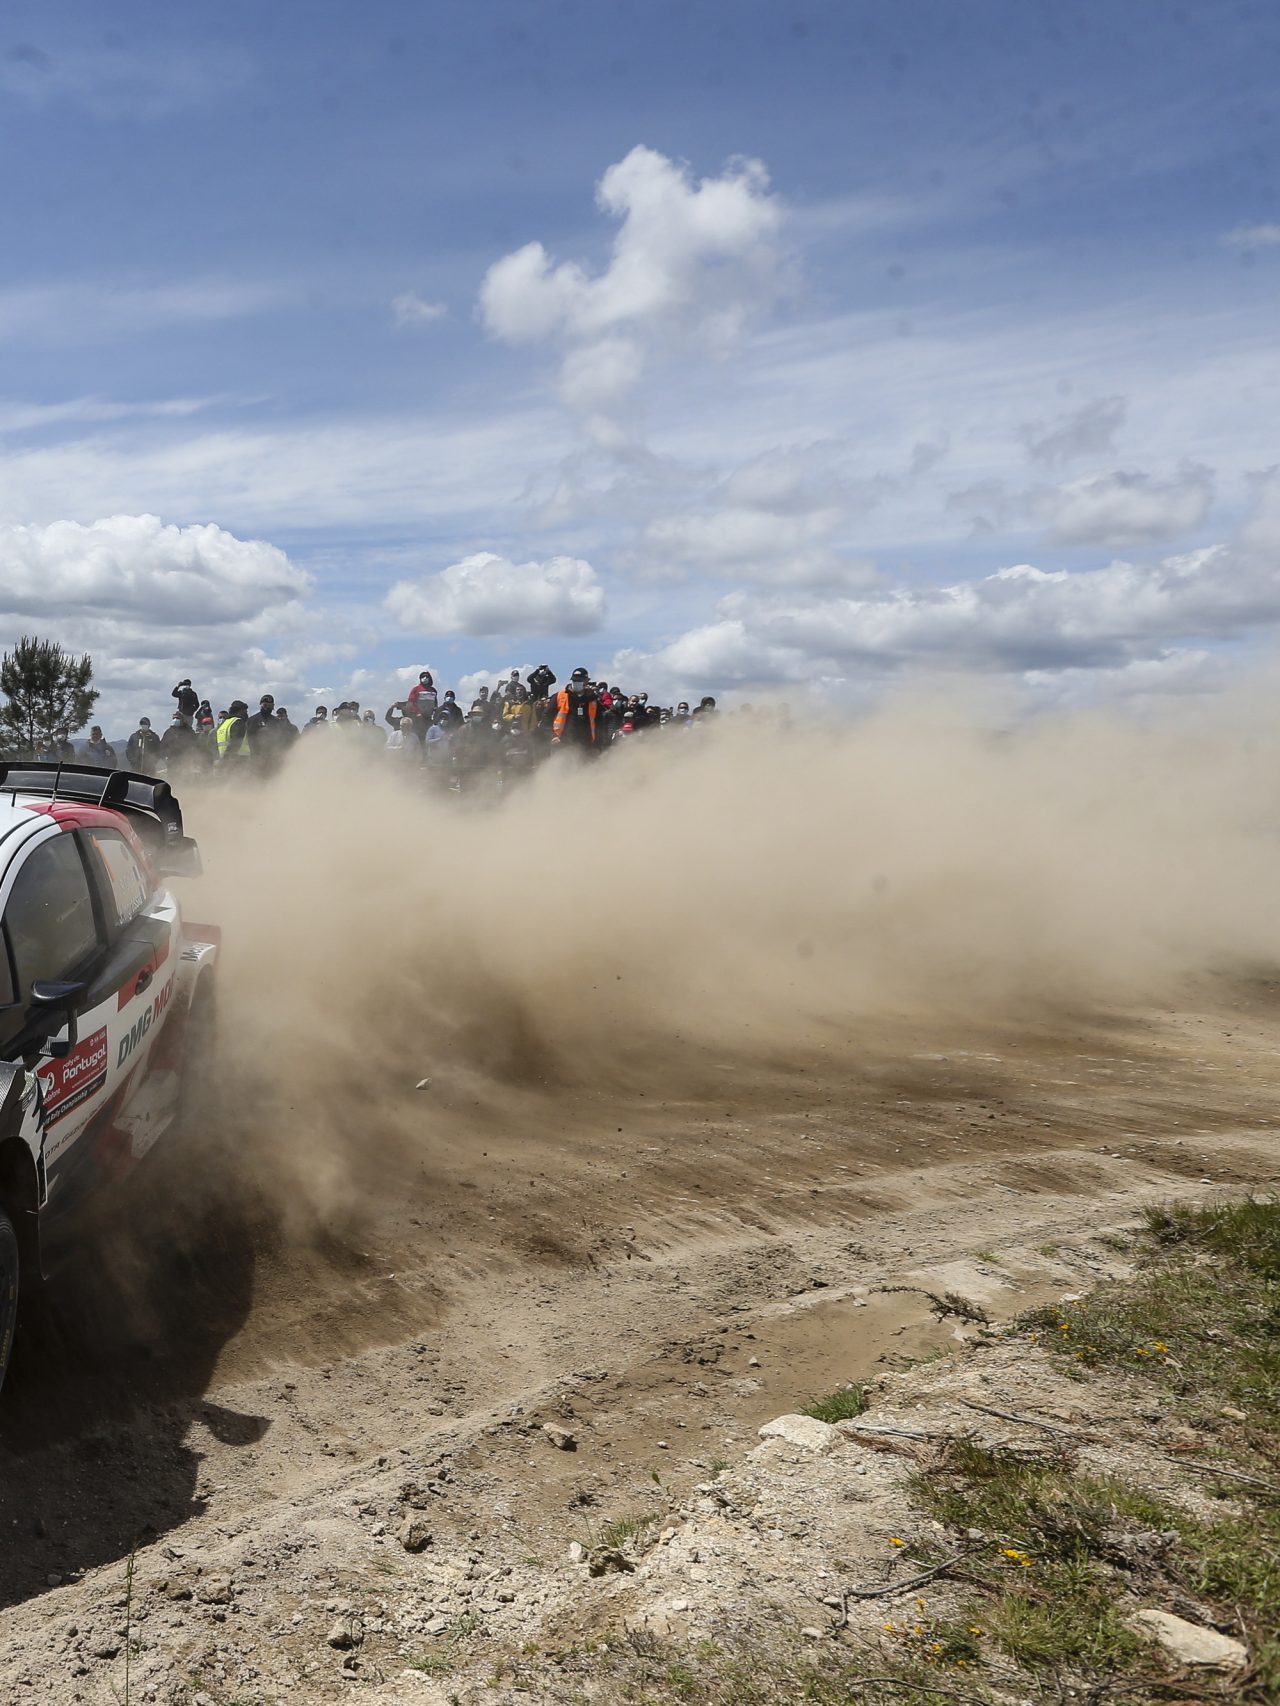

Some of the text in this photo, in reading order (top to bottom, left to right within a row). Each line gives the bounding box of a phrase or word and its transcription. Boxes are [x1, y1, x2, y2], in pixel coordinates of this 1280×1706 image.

[116, 1005, 152, 1070] DMG
[63, 1043, 107, 1084] Portugal
[63, 1058, 74, 1070] rally
